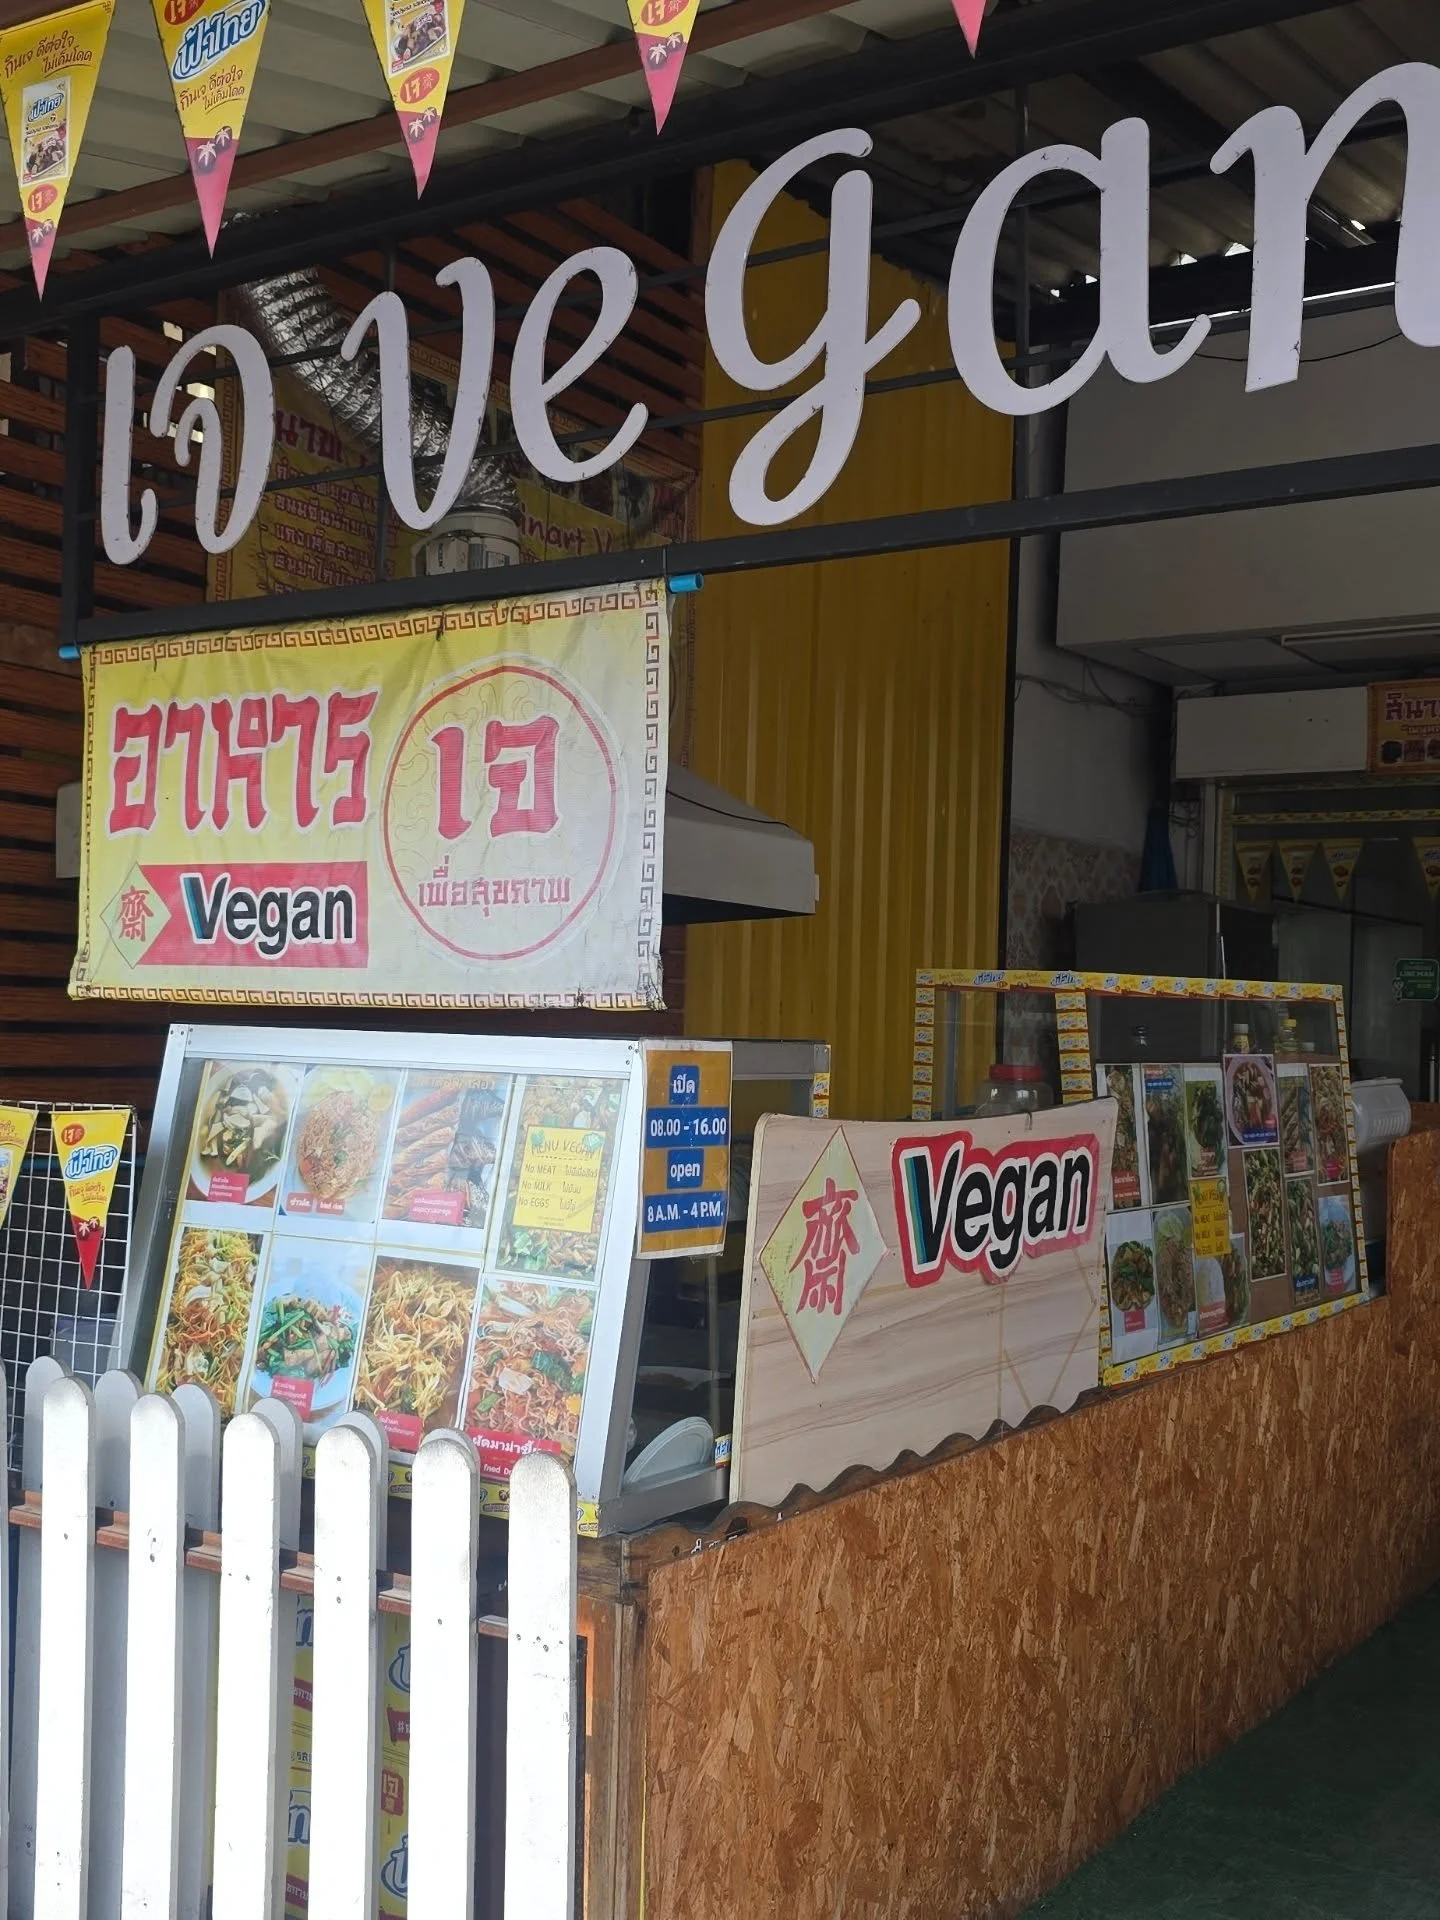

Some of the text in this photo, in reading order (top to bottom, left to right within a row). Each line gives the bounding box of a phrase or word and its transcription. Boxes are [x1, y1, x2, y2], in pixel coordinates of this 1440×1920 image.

[175, 1, 263, 78] ฟ้าไทย
[341, 62, 1440, 530] vegan
[108, 691, 379, 833] อาหาร
[180, 872, 354, 958] Vegan
[417, 855, 571, 917] เพื่อสุขภาพ
[672, 1073, 696, 1094] เปิด
[650, 1118, 681, 1137] 08.00
[693, 1117, 727, 1136] 16.00
[66, 1146, 117, 1179] ฟ้าไทย
[537, 1165, 557, 1175] MEAT
[670, 1162, 701, 1181] open
[902, 1146, 1092, 1272] Vegan
